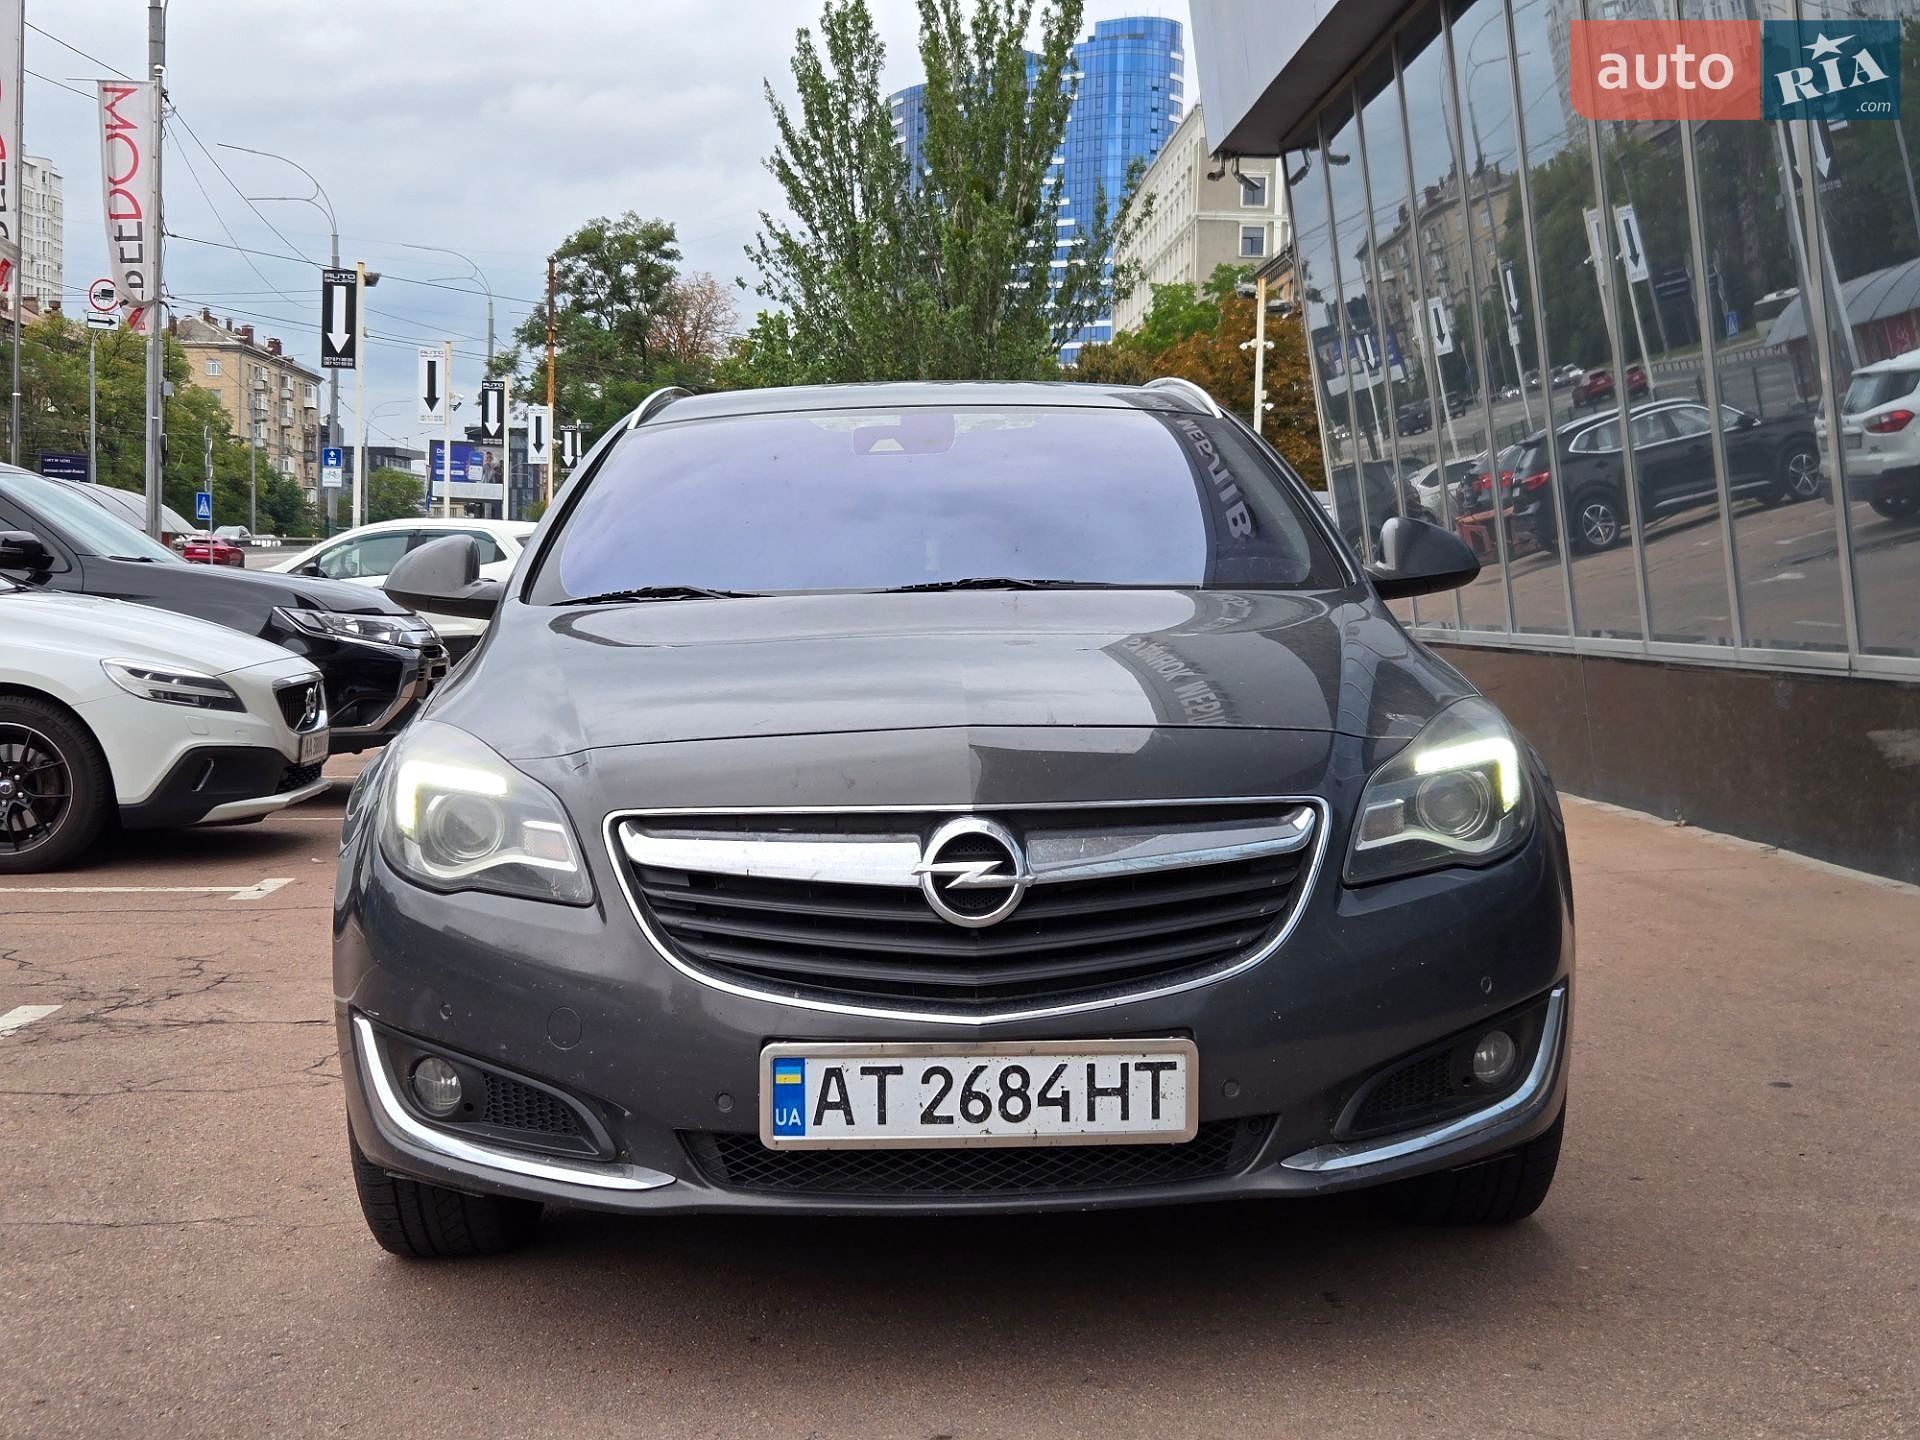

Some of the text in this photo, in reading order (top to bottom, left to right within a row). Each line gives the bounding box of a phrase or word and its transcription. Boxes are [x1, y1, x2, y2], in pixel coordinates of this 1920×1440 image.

[324, 272, 356, 280] AUTO
[812, 1061, 1178, 1126] AT 2684 HT
[775, 1107, 802, 1127] UA
